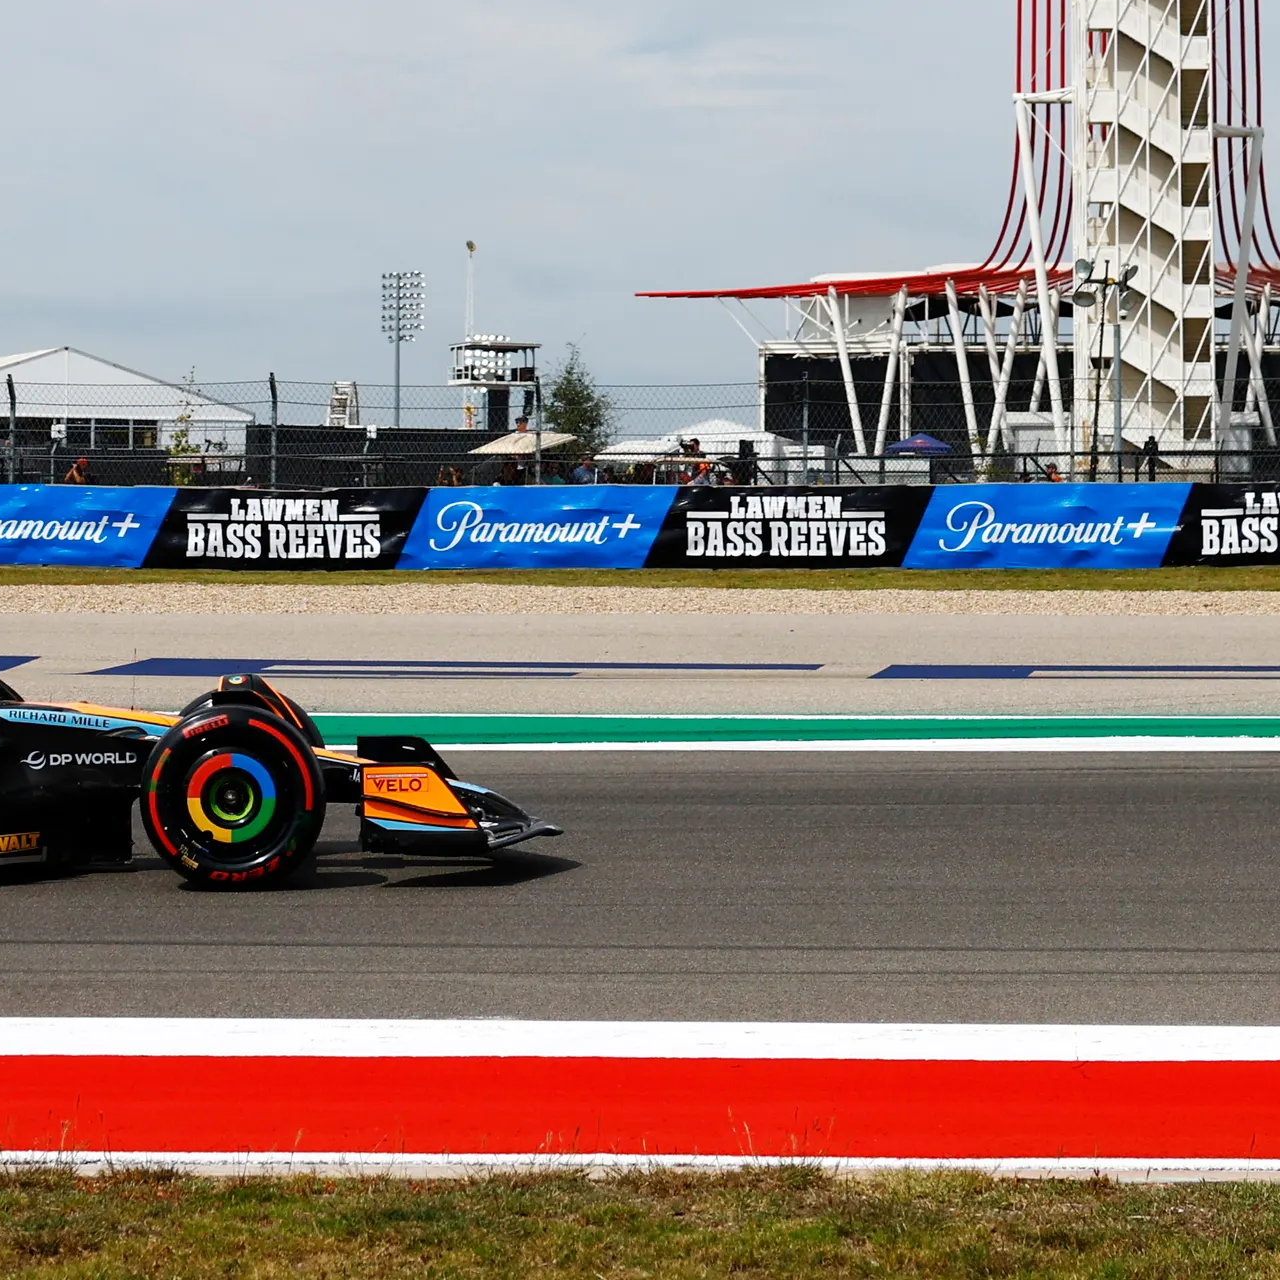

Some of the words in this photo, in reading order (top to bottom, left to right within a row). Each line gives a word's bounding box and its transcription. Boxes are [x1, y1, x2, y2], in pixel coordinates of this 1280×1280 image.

[229, 497, 339, 521] LAWMEN
[729, 495, 843, 519] LAWMEN
[186, 523, 262, 558] BASS
[267, 522, 381, 559] REEVES
[429, 501, 641, 551] Paramount+
[686, 520, 763, 557] BASS
[769, 520, 886, 557] REEVES
[938, 501, 1157, 552] Paramount+
[1201, 517, 1278, 556] BASS
[9, 709, 67, 724] RICHARD
[71, 715, 111, 728] MILLE
[49, 753, 72, 766] DP
[74, 751, 137, 765] WORLD
[372, 778, 422, 792] VELO
